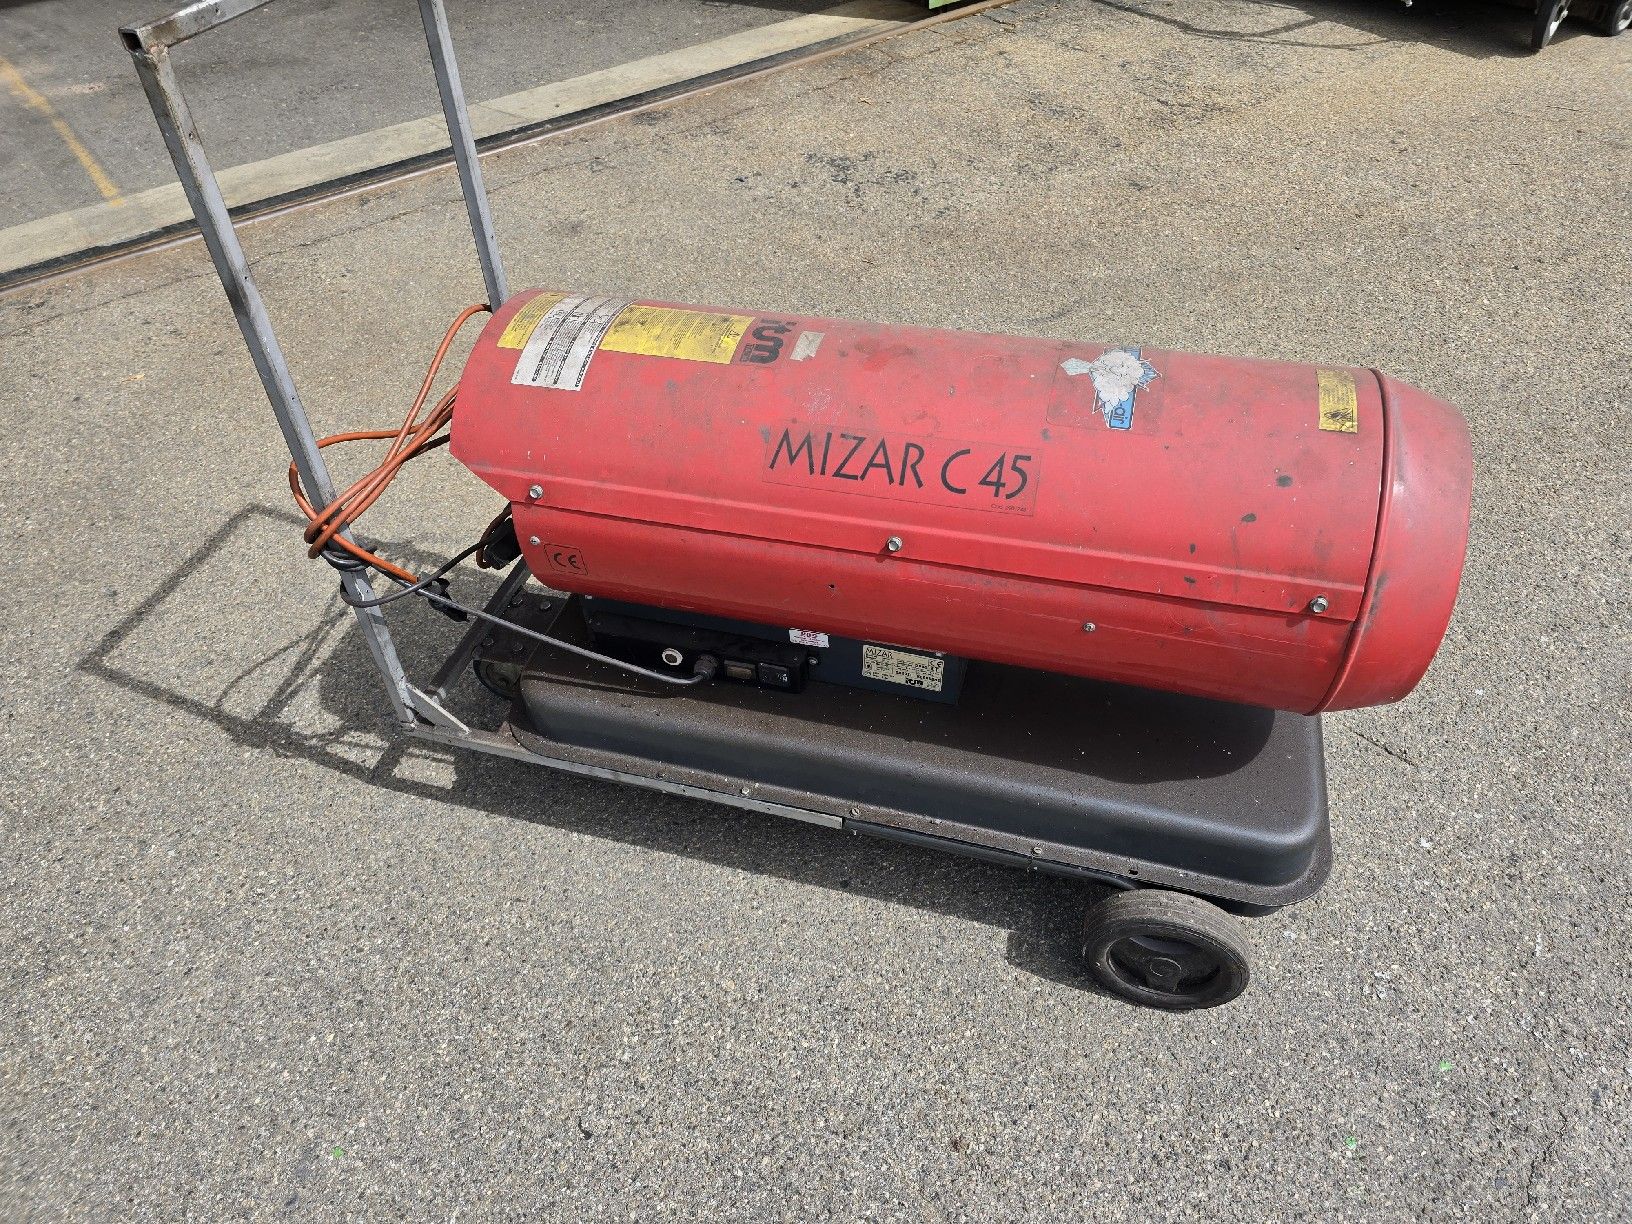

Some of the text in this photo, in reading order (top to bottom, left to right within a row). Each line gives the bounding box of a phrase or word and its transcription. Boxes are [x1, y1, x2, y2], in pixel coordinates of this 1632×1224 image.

[769, 427, 1032, 500] MIZAR C 45
[865, 647, 893, 659] MIZAR
